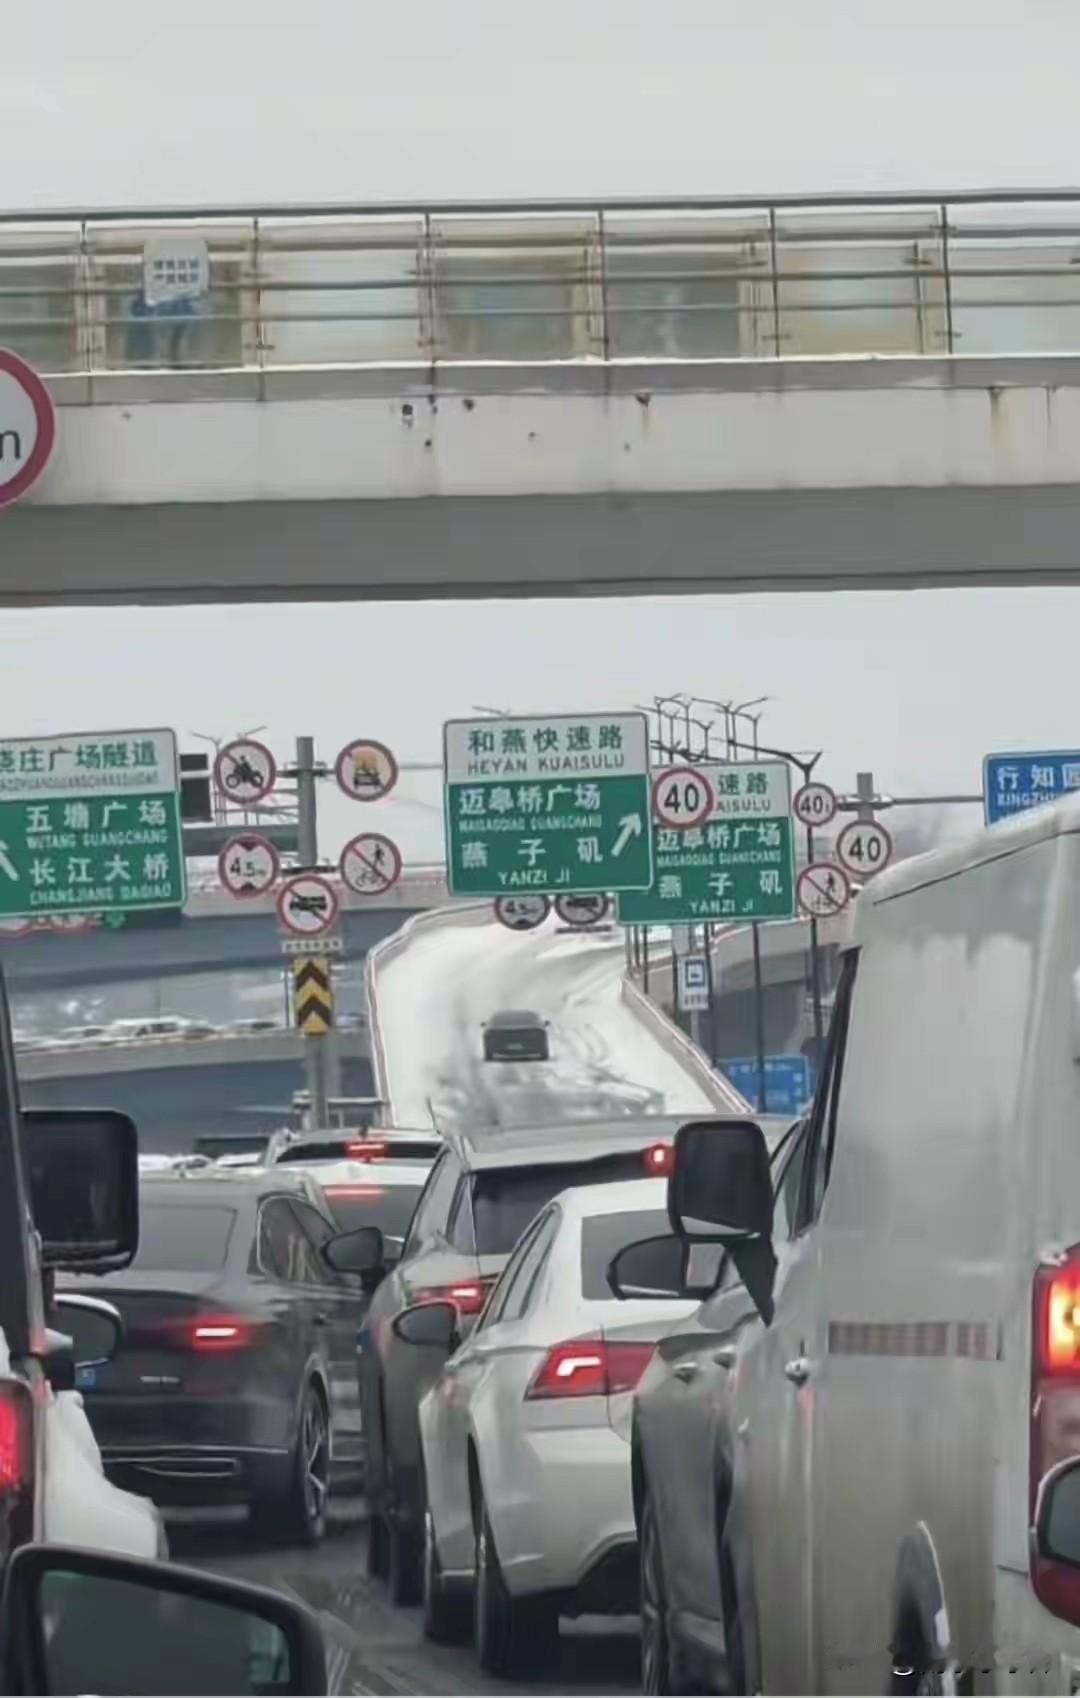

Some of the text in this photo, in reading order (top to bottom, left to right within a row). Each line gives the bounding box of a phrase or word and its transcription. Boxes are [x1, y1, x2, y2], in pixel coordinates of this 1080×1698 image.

[467, 724, 623, 756] 和燕快速路
[467, 753, 625, 777] HEYAN KUAISULU
[458, 783, 601, 815] 迈皋桥广场
[664, 783, 700, 813] 40
[26, 799, 167, 833] 五塘广场
[461, 836, 603, 869] 燕子矶
[848, 836, 881, 863] 40
[29, 852, 169, 886] 长江大桥
[498, 868, 571, 886] YANZI JI
[658, 869, 784, 899] 燕子矶
[689, 898, 754, 913] YANZI JI
